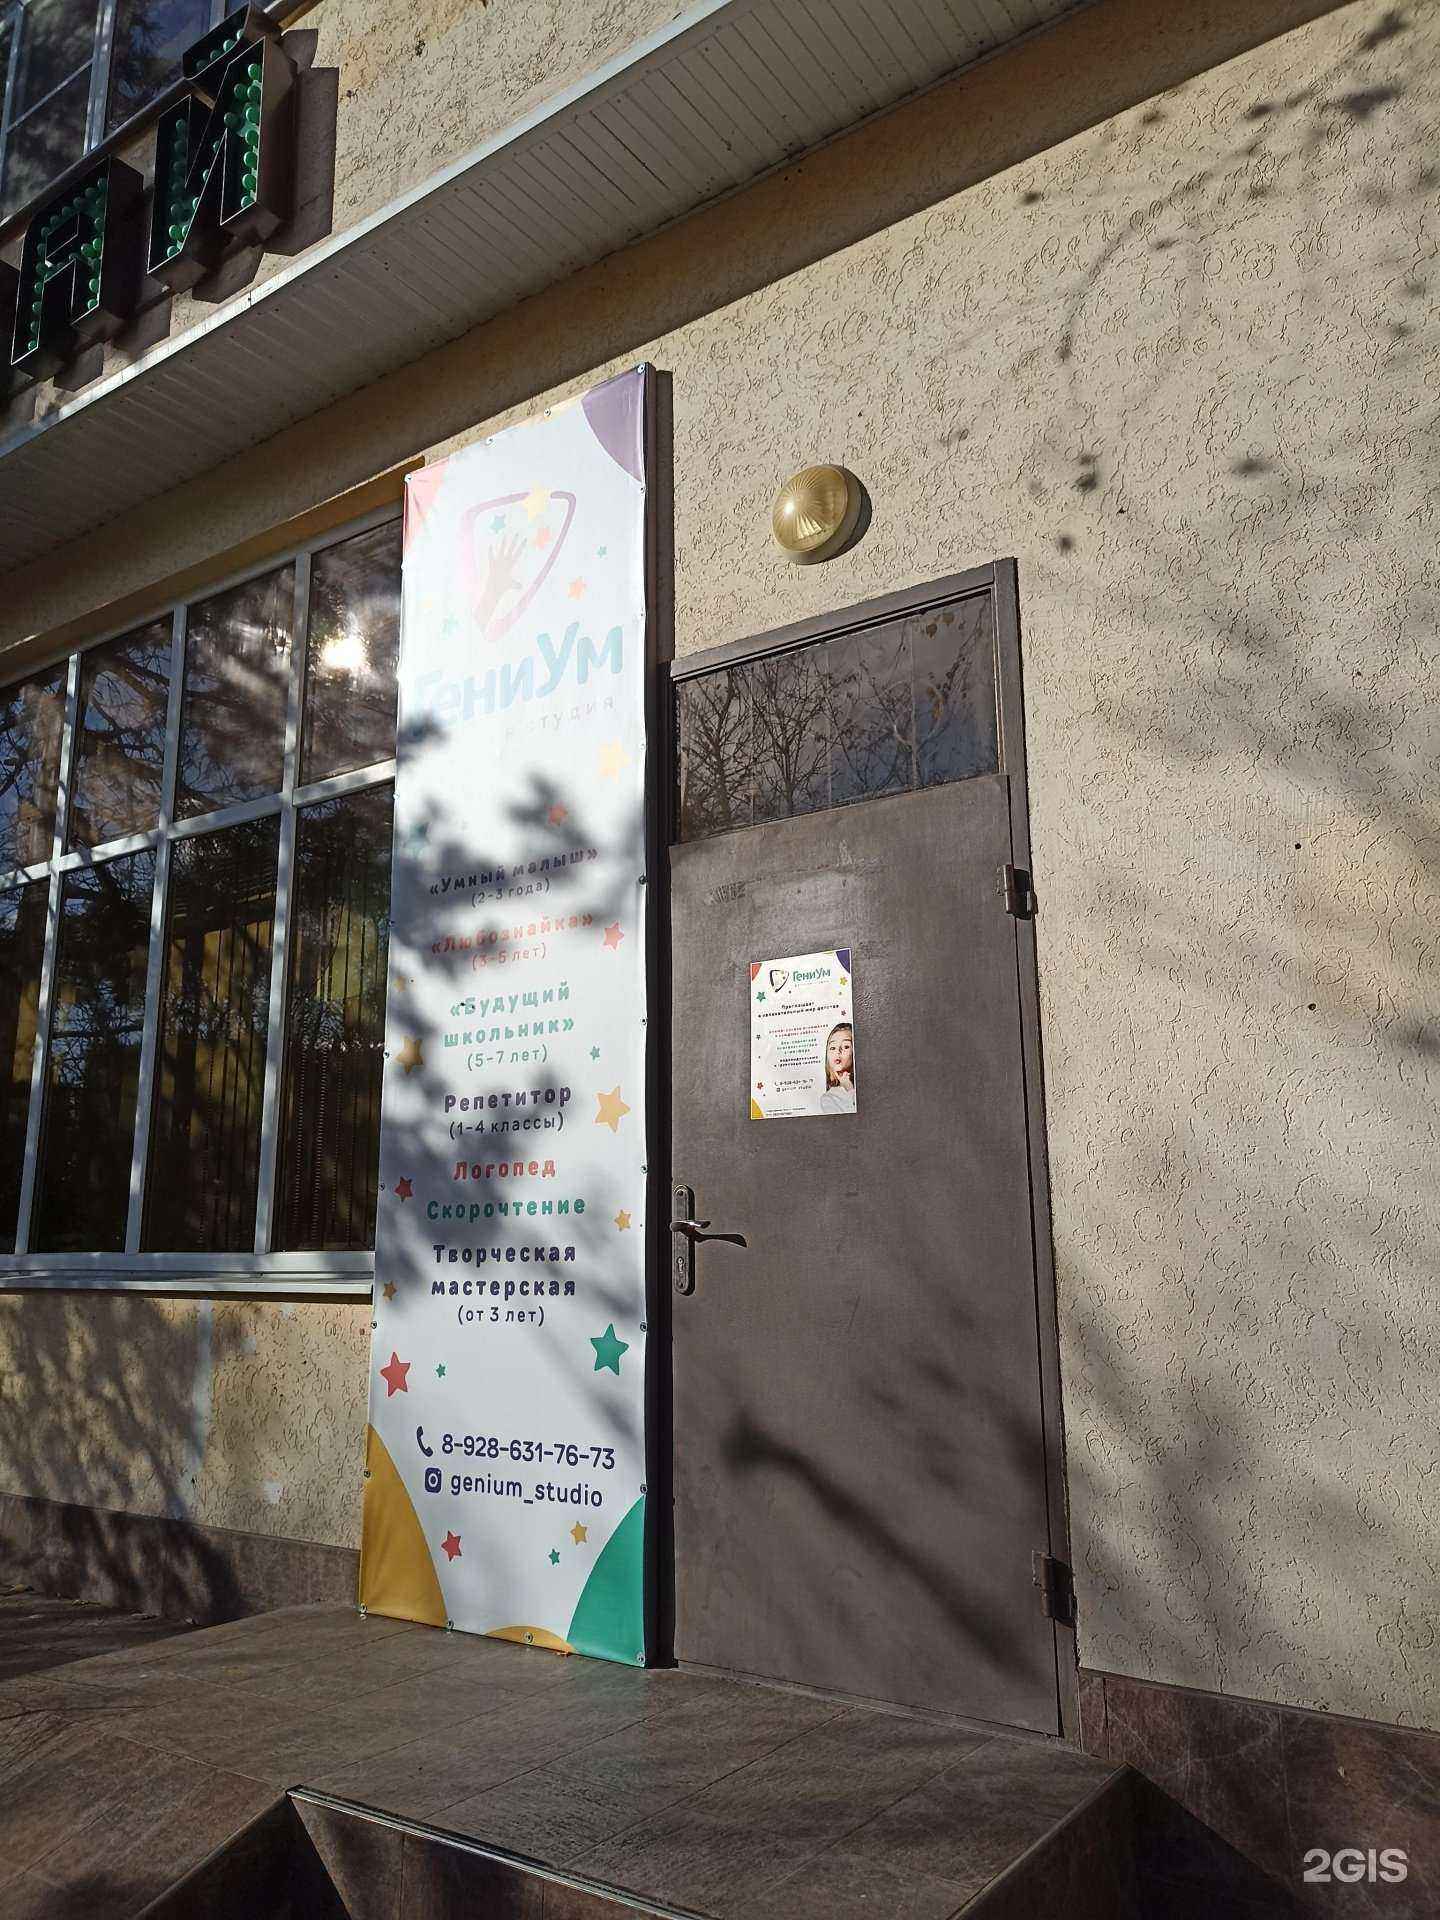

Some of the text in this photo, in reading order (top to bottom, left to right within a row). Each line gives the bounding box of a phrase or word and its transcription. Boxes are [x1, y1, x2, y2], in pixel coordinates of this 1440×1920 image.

[429, 848, 599, 896] «Умный малыш»
[507, 878, 551, 899] года)
[431, 912, 594, 955] «Любознайка»
[511, 942, 547, 962] лет)
[793, 967, 831, 983] ГениУм
[450, 981, 570, 1018] «Будущий
[443, 1016, 575, 1048] школьник»
[467, 1044, 548, 1072] (5-7 лет)
[444, 1086, 572, 1114] Репетитор
[449, 1111, 565, 1140] (1-4 классы)
[453, 1159, 557, 1181] Логопед
[426, 1198, 587, 1223] Скорочтение
[432, 1244, 576, 1268] Творческая
[431, 1279, 576, 1301] мастерская
[457, 1305, 545, 1327] (от 3 лет)
[441, 1433, 616, 1470] 8-928-631-76-73
[450, 1473, 604, 1508] genium_studio
